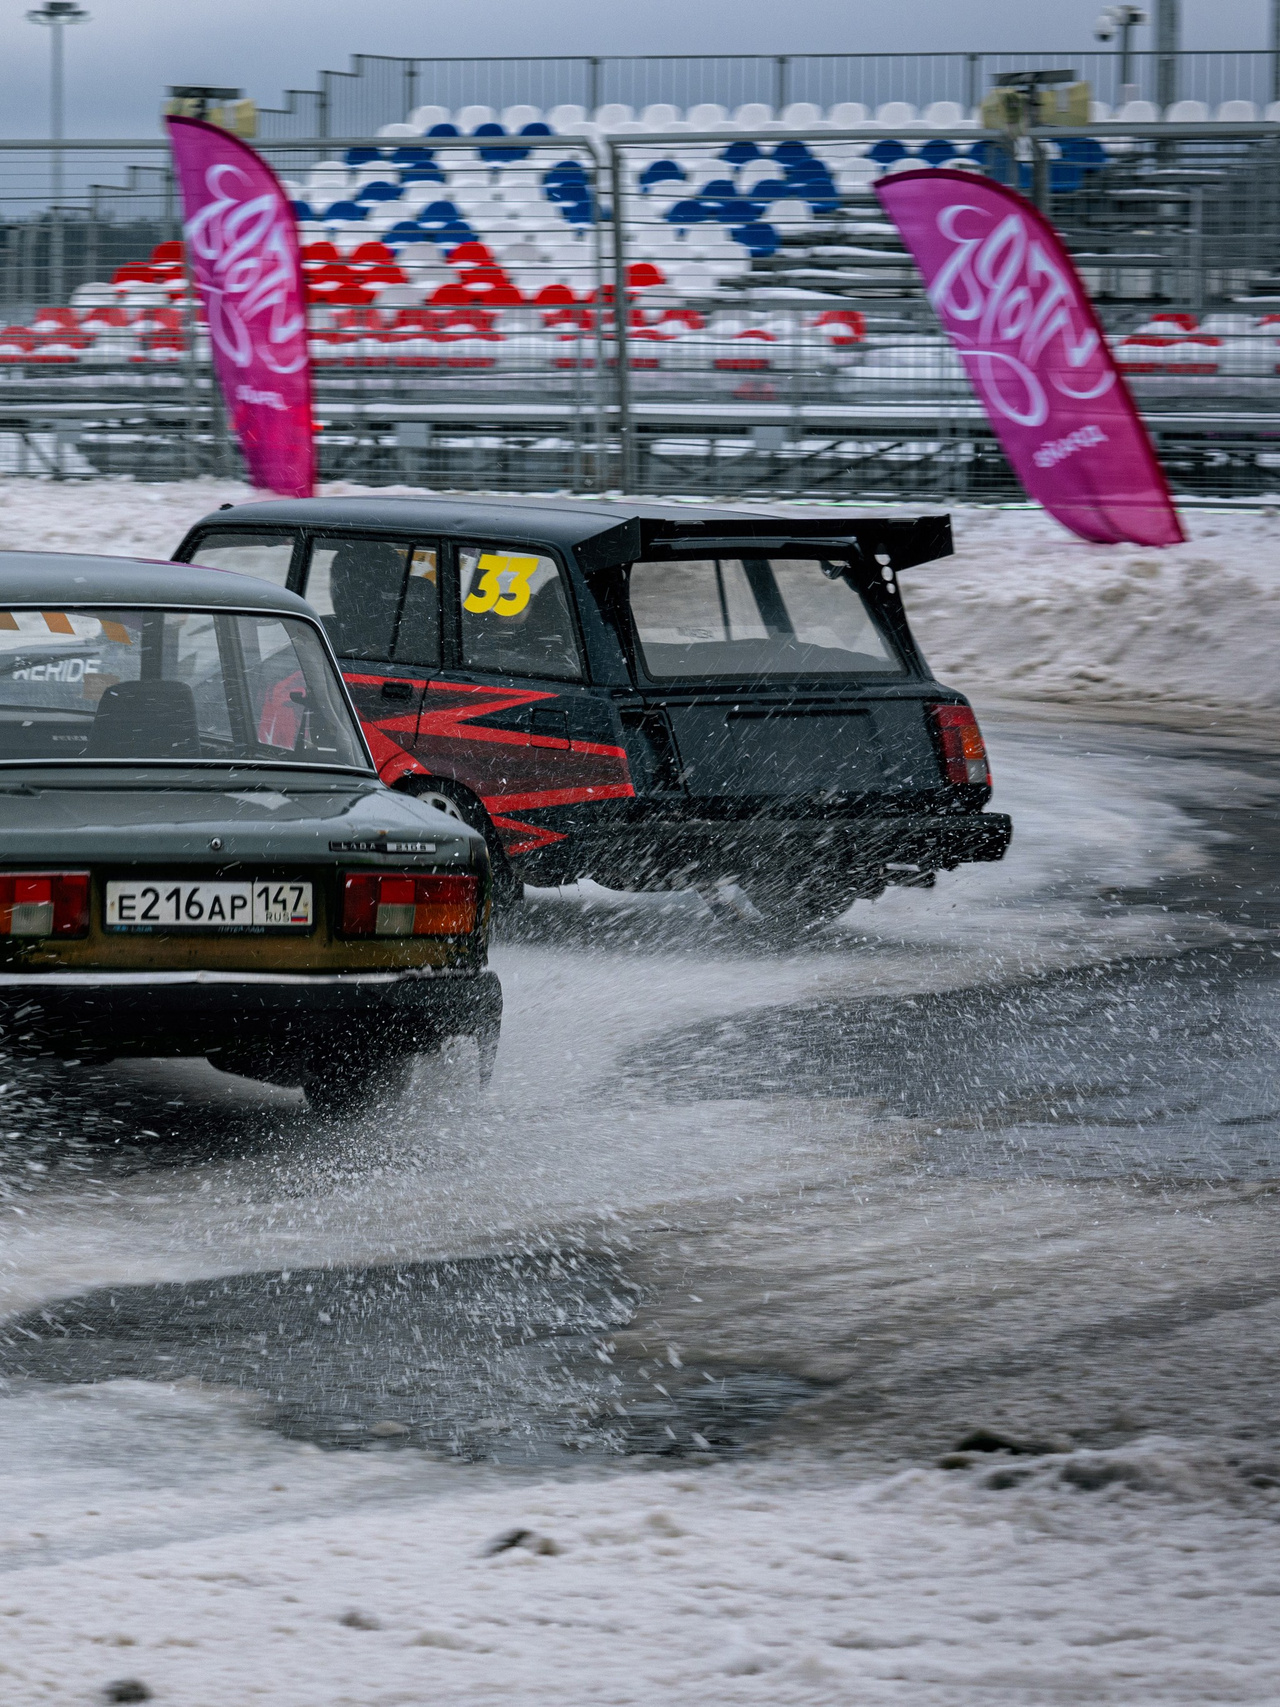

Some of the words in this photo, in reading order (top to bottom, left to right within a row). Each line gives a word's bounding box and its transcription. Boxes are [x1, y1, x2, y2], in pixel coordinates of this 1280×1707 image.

[463, 554, 539, 617] 33
[341, 841, 376, 850] LADA
[256, 886, 304, 912] 147
[265, 911, 290, 923] RUS
